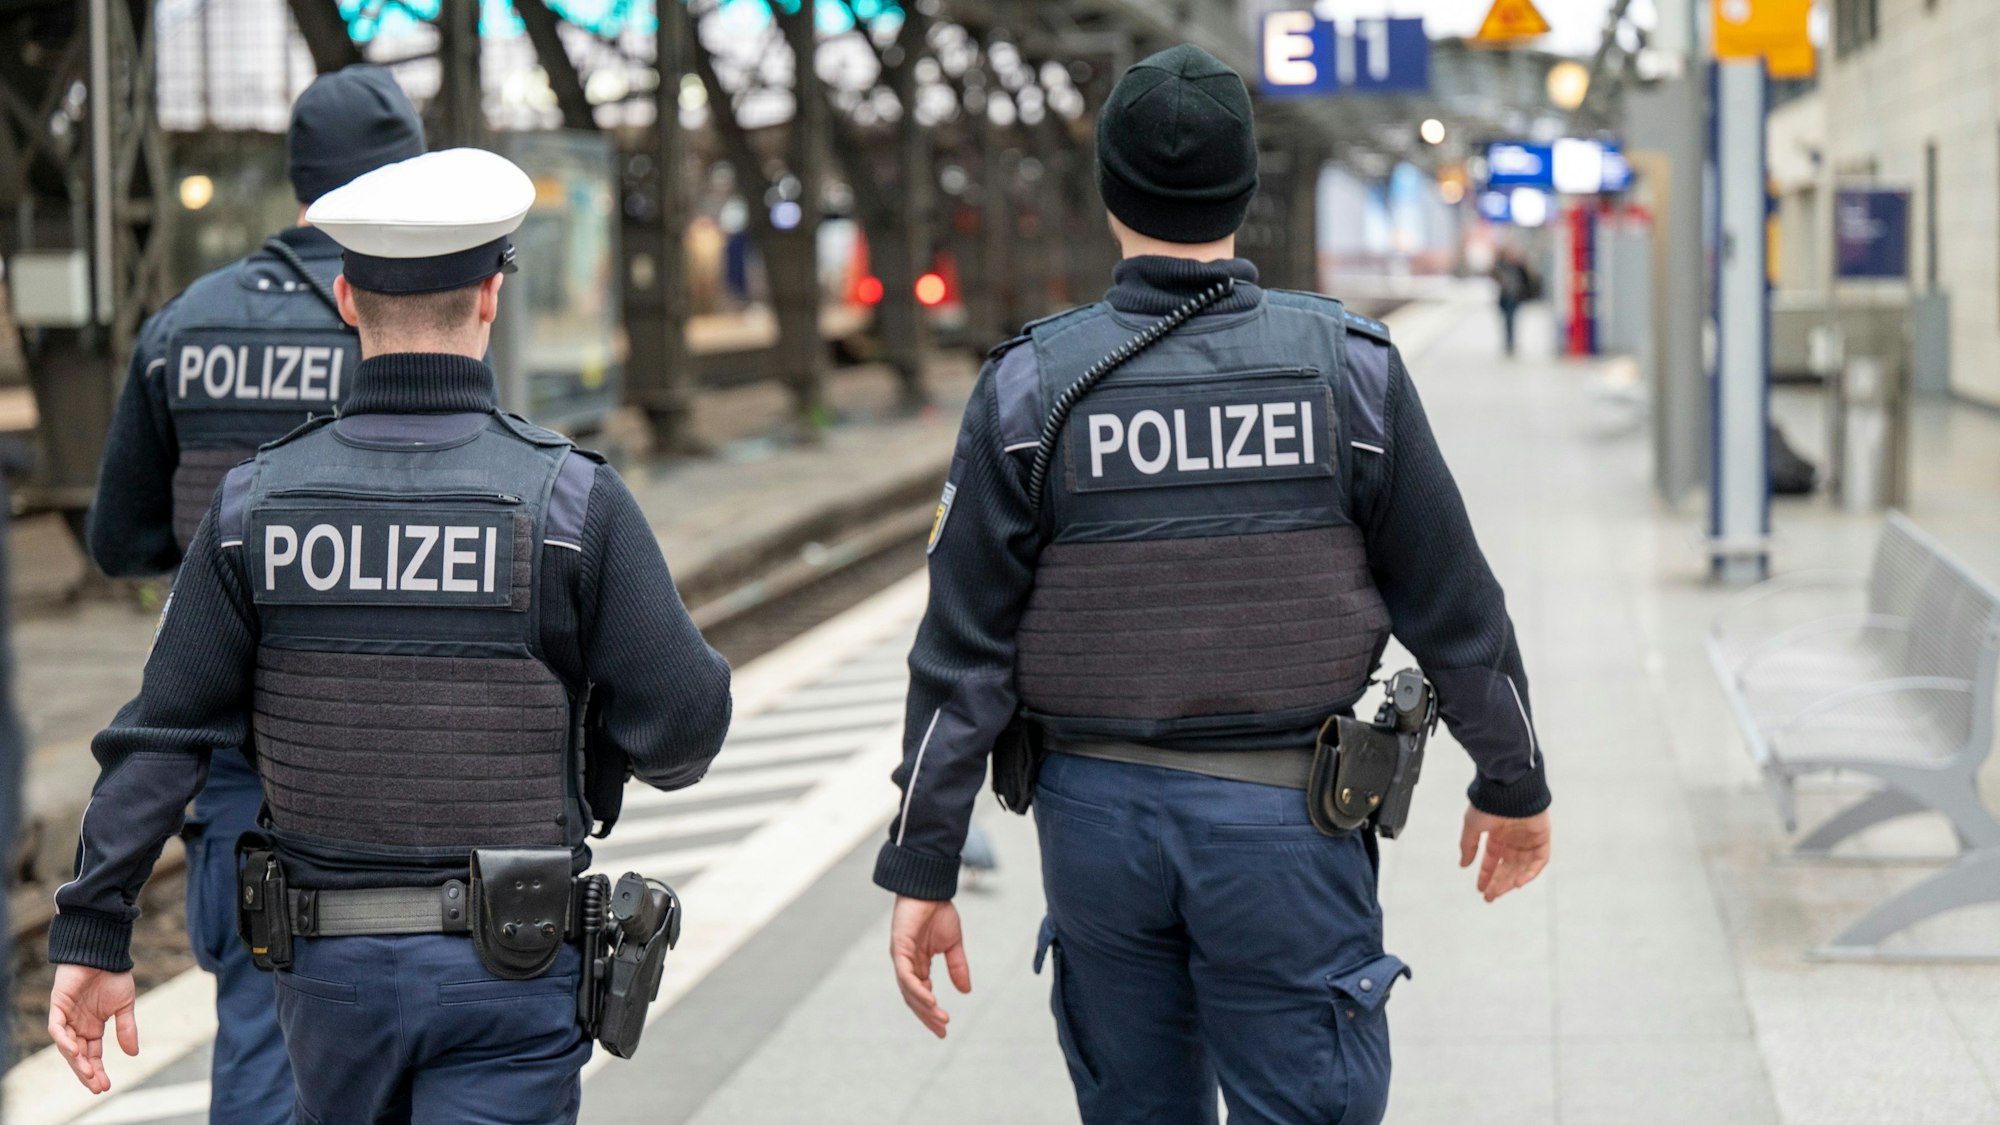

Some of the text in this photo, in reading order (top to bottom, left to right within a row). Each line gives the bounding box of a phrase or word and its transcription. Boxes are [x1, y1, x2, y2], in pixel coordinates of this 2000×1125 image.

[1264, 10, 1317, 85] E
[179, 345, 344, 400] POLIZEI
[1088, 401, 1315, 478] POLIZEI
[264, 523, 497, 592] POLIZEI
